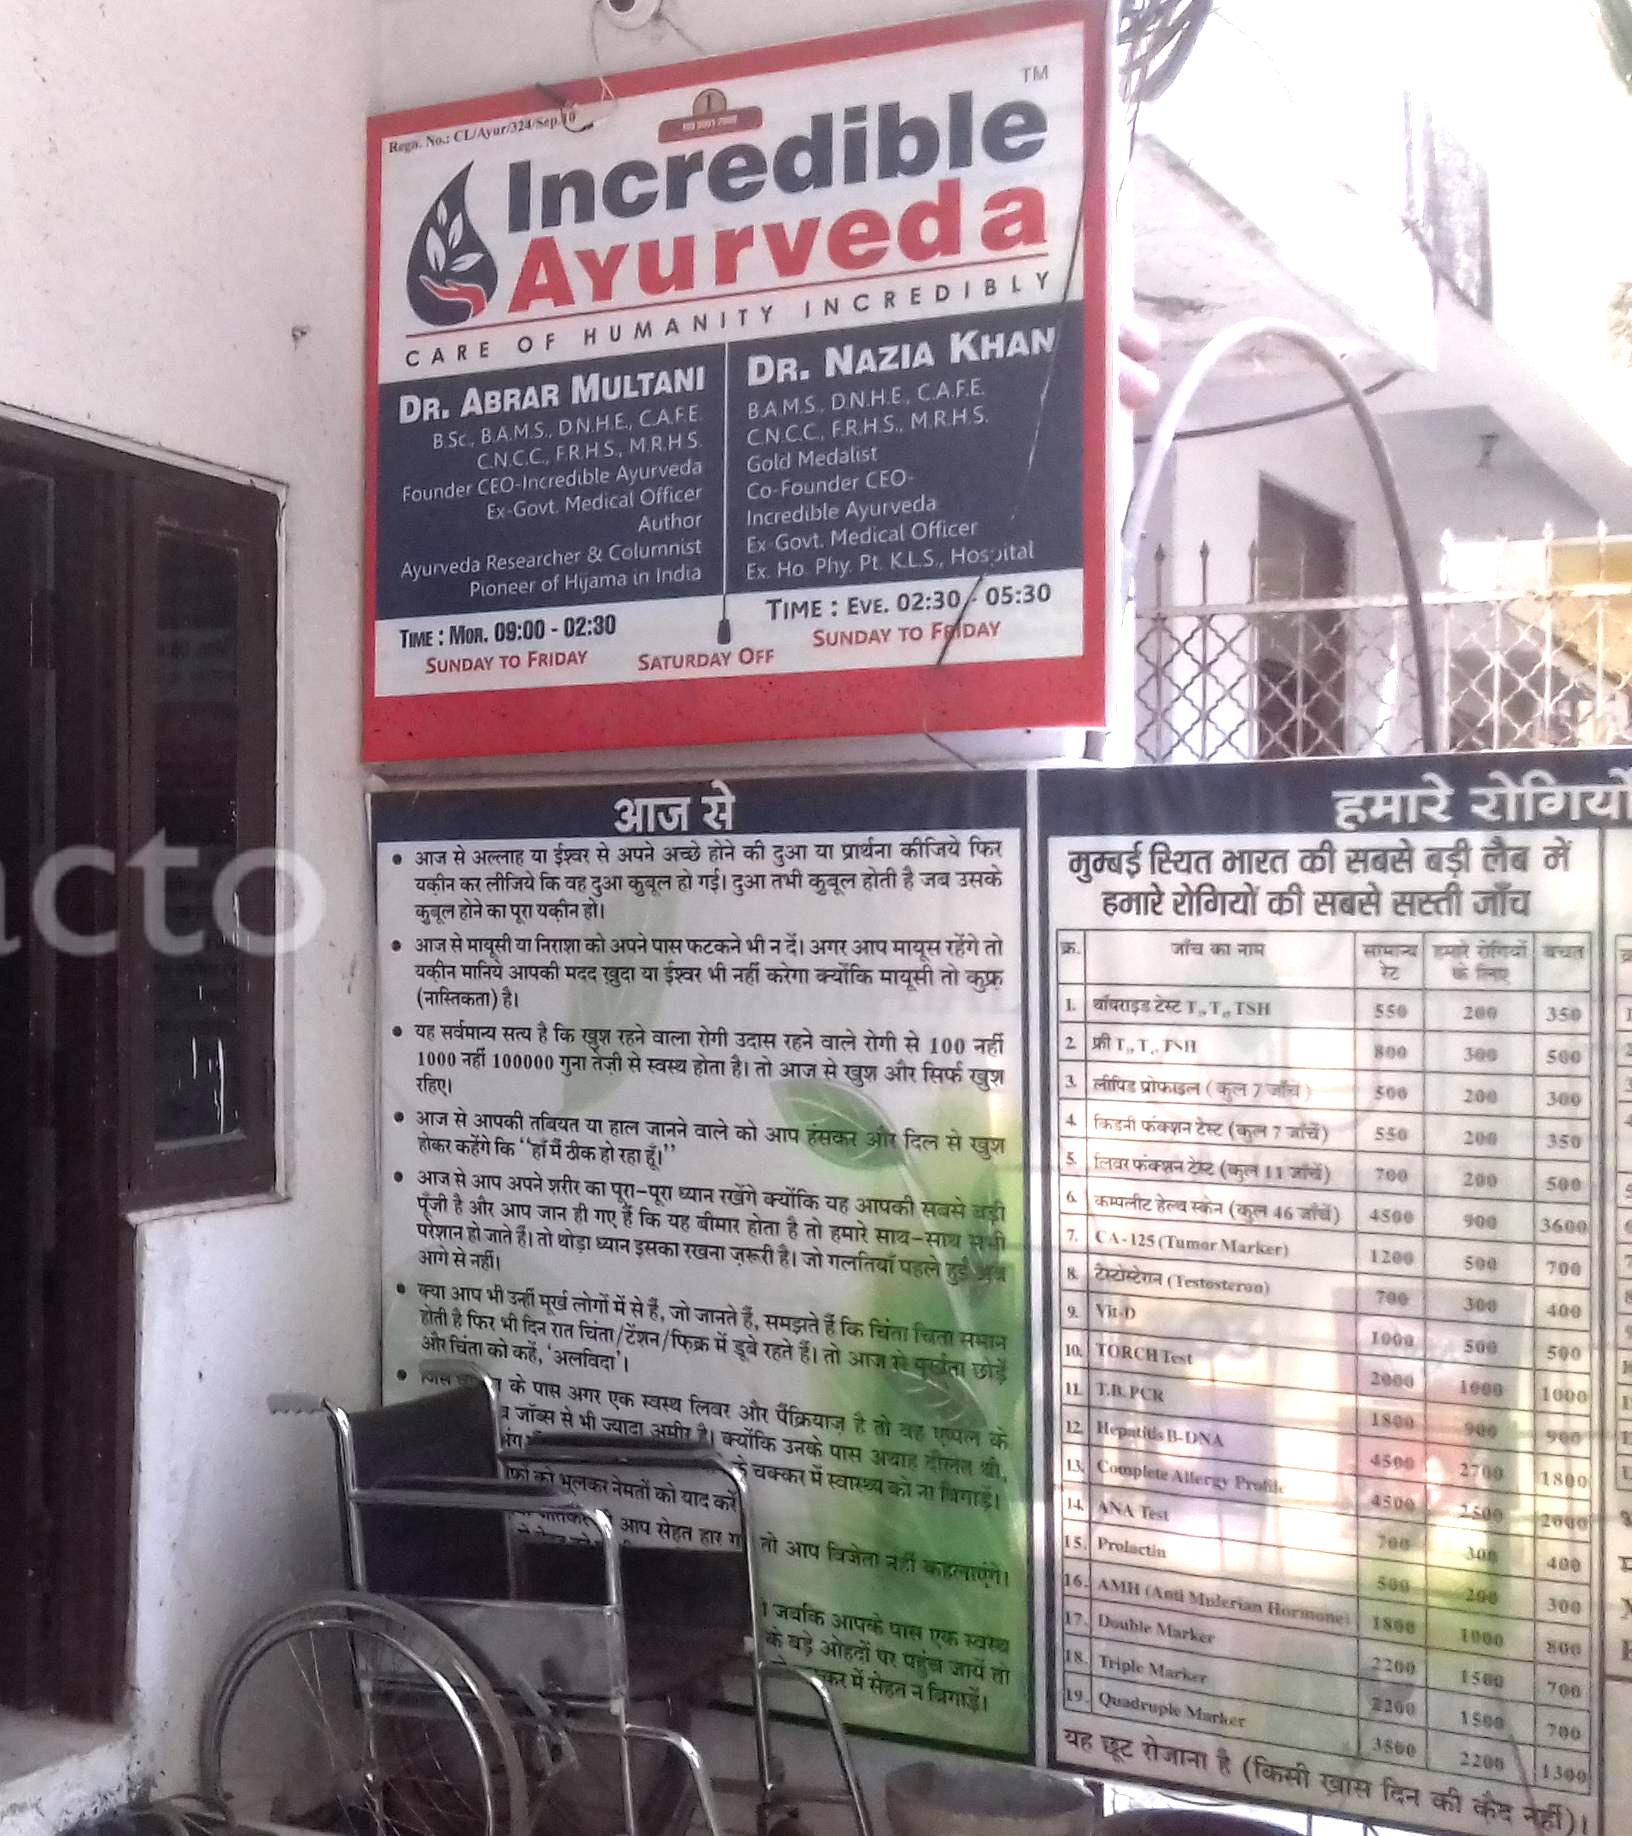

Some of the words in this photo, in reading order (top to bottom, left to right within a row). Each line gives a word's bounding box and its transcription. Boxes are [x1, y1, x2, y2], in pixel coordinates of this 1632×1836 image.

[1023, 66, 1048, 82] TM
[508, 90, 1048, 233] Incredible
[406, 342, 489, 367] CARE
[518, 333, 555, 354] OF
[584, 306, 772, 346] HUMANITY
[806, 272, 1049, 318] INCREDIBLY
[747, 452, 790, 473] Gold
[798, 445, 878, 469] Medalist
[402, 481, 472, 502] Founder
[477, 466, 609, 496] CEO-Incredible
[616, 458, 703, 484] Ayurveda
[747, 474, 860, 500] Co-Founder
[866, 469, 915, 489] CEO-
[487, 500, 558, 520] Ex-Govt.
[565, 493, 633, 513] Medical
[640, 486, 703, 507] Officer
[747, 500, 839, 526] Incredible
[845, 494, 937, 522] Ayurveda
[638, 512, 703, 532] Author
[775, 532, 825, 552] Govt.
[831, 524, 905, 547] Medical
[911, 519, 979, 543] Officer
[401, 553, 480, 582] Ayurveda
[486, 547, 581, 572] Researcher
[587, 546, 602, 564] &
[609, 538, 702, 561] Columnist
[469, 580, 536, 598] Pioneer
[542, 574, 559, 593] of
[564, 572, 626, 594] Hijama
[633, 570, 650, 585] in
[657, 564, 702, 584] India
[832, 599, 838, 617] :
[896, 589, 961, 612] 02:30
[986, 582, 1052, 606] 05:30
[438, 629, 444, 645] :
[494, 618, 545, 642] 09:00
[563, 613, 616, 637] 02:30
[614, 796, 691, 833] आज
[701, 779, 736, 831] से
[1331, 772, 1455, 832] हमारे
[414, 850, 447, 865] आज
[453, 845, 466, 865] से
[472, 849, 524, 865] अल्लाह
[530, 850, 547, 864] या
[554, 842, 590, 868] ईश्वर
[596, 843, 610, 864] से
[617, 841, 655, 863] अपने
[662, 840, 700, 863] अच्छे
[708, 839, 735, 864] होने
[742, 840, 766, 861] की
[772, 843, 808, 867] दुआ
[814, 844, 834, 860] या
[840, 836, 892, 860] प्रार्थना
[899, 835, 961, 859] कीजिये
[968, 835, 1003, 858] फिर
[1067, 840, 1142, 883] मुम्बई
[1149, 841, 1214, 875] स्थित
[1222, 848, 1290, 875] भारत
[1297, 839, 1337, 875] की
[1344, 838, 1415, 874] सबसे
[1423, 837, 1473, 878] बड़ी
[1480, 836, 1531, 872] लैब
[1543, 835, 1573, 872] में
[1101, 882, 1165, 917] हमारे
[1172, 882, 1261, 916] रोगियों
[1266, 882, 1306, 916] की
[1313, 881, 1383, 916] सबसे
[1390, 881, 1464, 917] सस्ती
[1471, 882, 1532, 917] जाँच
[1371, 1248, 1414, 1266] 1200
[1464, 1256, 1497, 1271] 500
[1547, 1261, 1582, 1277] 700
[1063, 1728, 1093, 1750] यह
[1100, 1734, 1134, 1763] छूट
[1141, 1733, 1208, 1771] रोजाना
[1215, 1748, 1231, 1775] है
[1382, 1776, 1420, 1807] दिन
[1430, 1786, 1463, 1813] की
